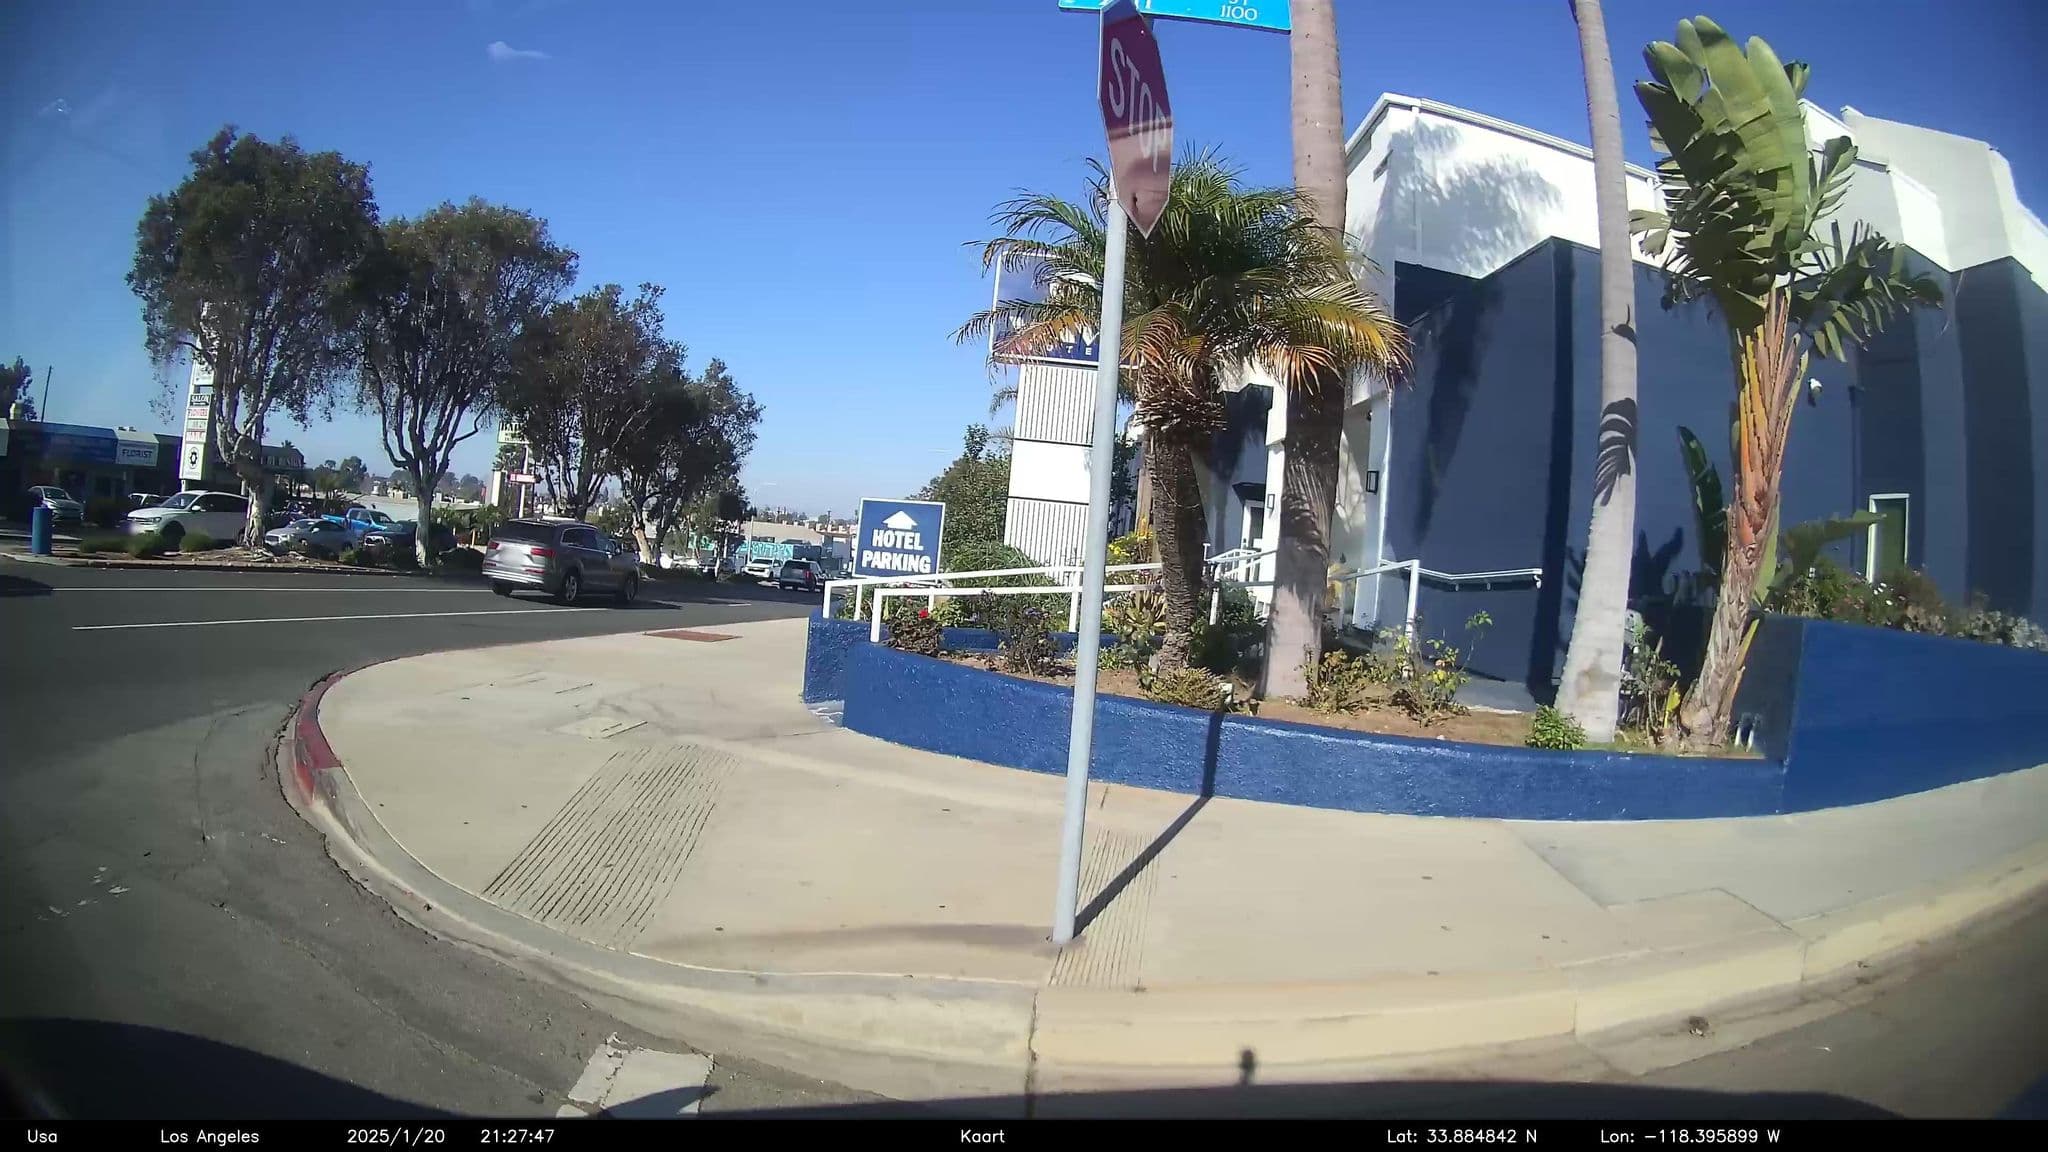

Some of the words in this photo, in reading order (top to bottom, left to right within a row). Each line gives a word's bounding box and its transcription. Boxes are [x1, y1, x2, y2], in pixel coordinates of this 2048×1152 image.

[1220, 5, 1258, 21] 1100
[1108, 37, 1168, 173] STOP
[122, 449, 153, 458] FLORIST
[872, 529, 924, 551] HOTEL
[861, 550, 931, 574] PARKING
